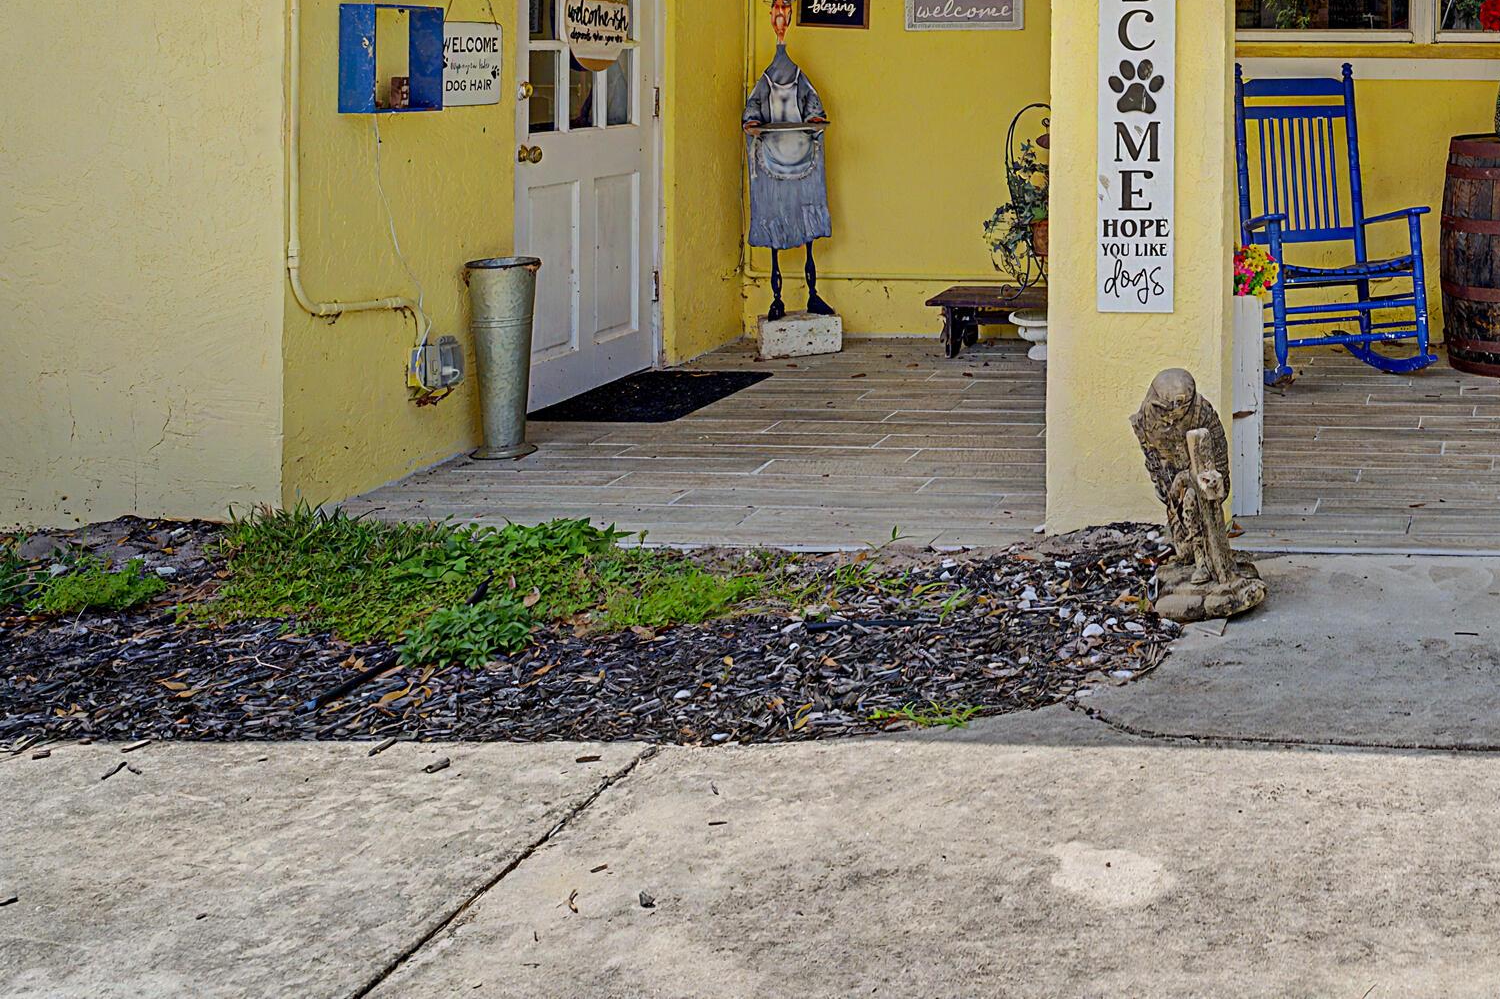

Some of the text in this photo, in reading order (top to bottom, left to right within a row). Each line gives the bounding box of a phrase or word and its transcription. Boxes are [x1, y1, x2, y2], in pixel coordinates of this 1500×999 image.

[445, 79, 492, 92] DOG HAIR
[1103, 219, 1170, 238] HOPE
[1102, 243, 1168, 258] YOU LIKE
[1104, 258, 1165, 305] dogs
